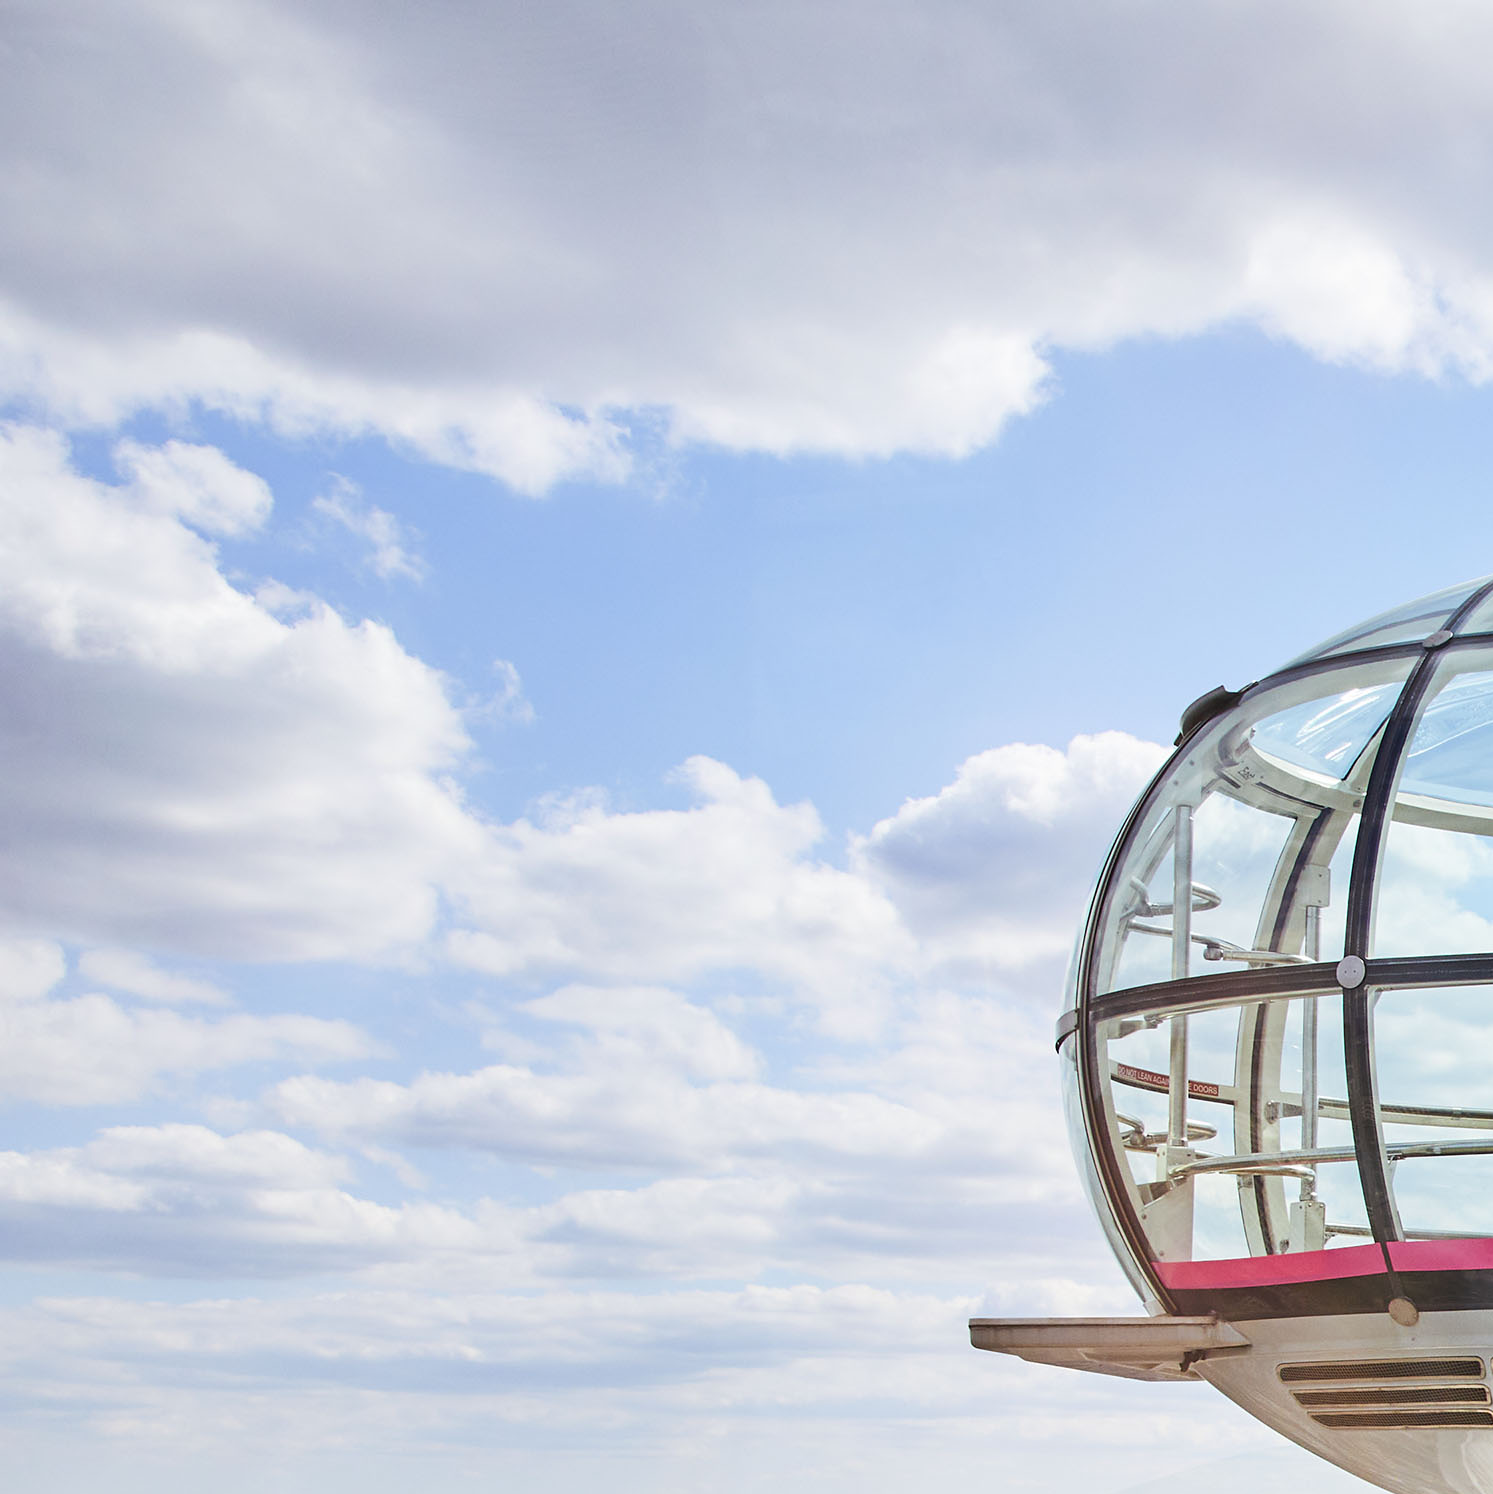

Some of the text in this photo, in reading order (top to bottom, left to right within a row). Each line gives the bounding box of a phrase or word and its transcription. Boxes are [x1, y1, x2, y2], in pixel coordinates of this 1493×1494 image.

[1126, 1067, 1137, 1078] NOT
[1137, 1069, 1153, 1082] LEAN
[1153, 1074, 1170, 1086] AGAI
[1193, 1085, 1218, 1095] DOORS
